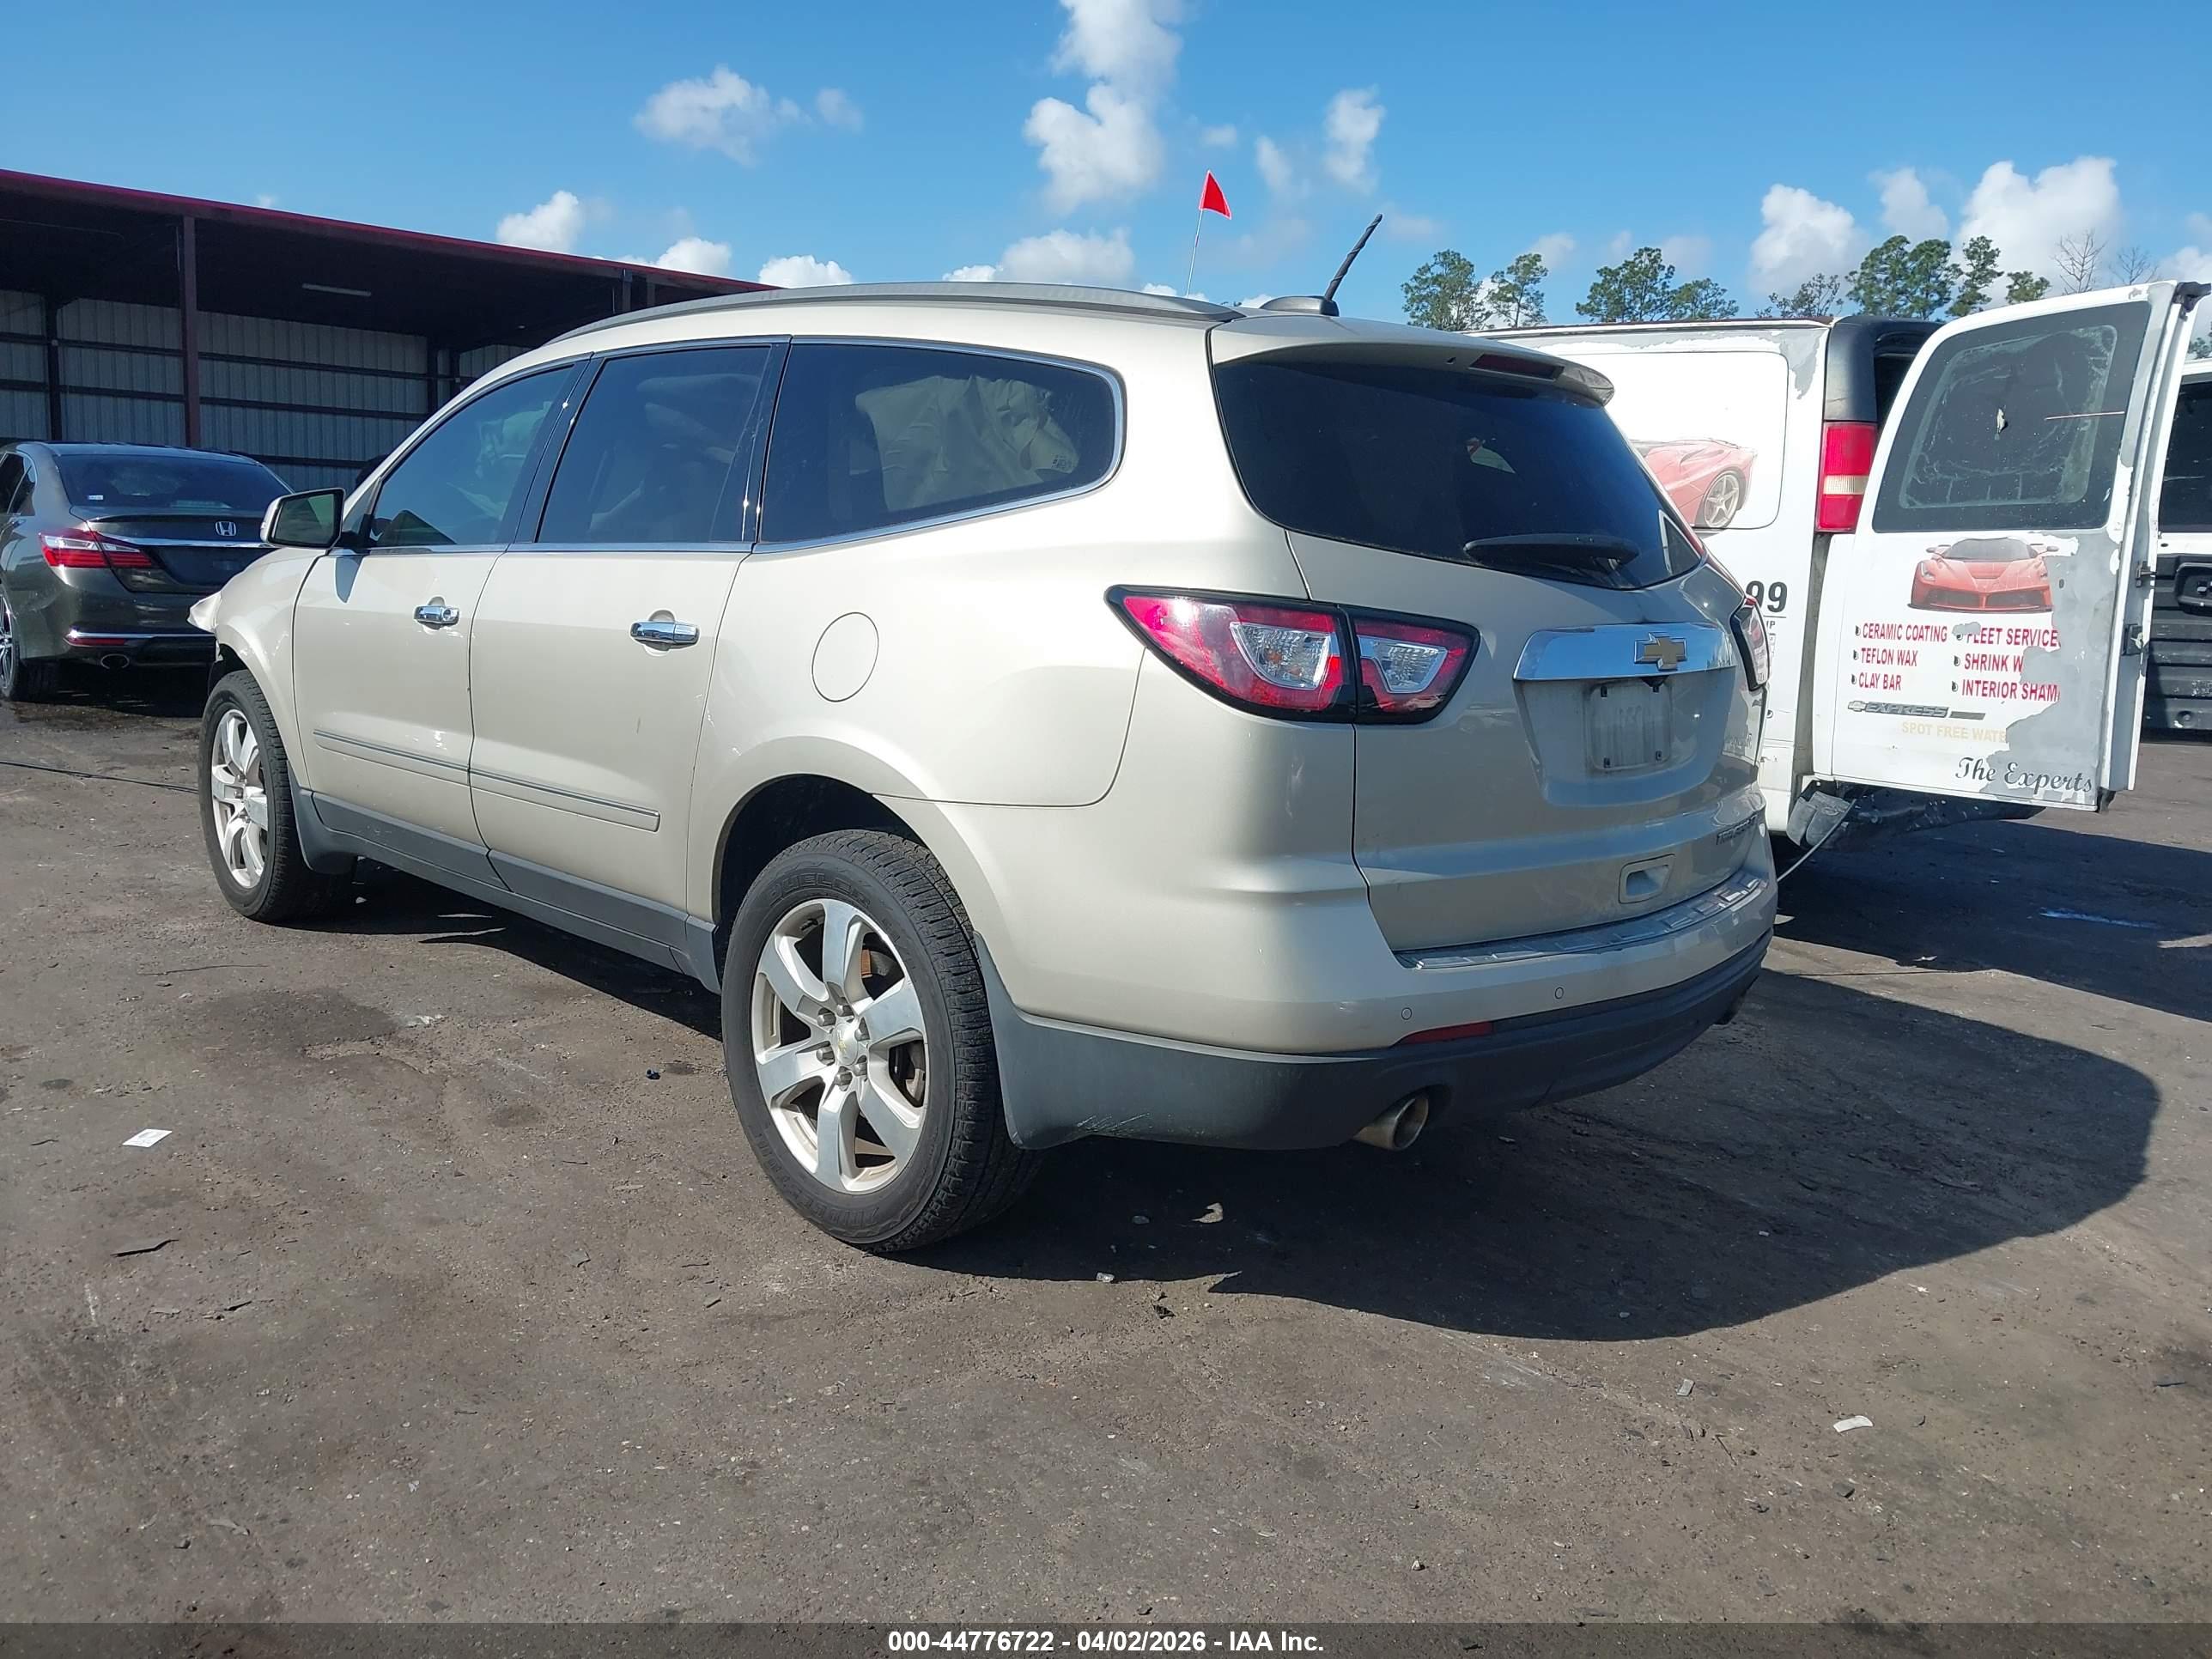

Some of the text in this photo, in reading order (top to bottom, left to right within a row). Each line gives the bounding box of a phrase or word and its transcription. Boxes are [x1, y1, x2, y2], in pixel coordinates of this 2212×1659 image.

[1863, 623, 1948, 643] CERAMIC COATING
[2005, 628, 2062, 648] SERVICE
[1861, 647, 1918, 667] TEFLON WAX
[1964, 653, 2009, 672] SHRINK
[1858, 672, 1902, 691] CLAY BAR
[1961, 678, 2018, 700] INTERIOR
[1865, 701, 1949, 719] EXPRESS
[1902, 720, 1933, 736] SPOT
[1936, 725, 1969, 740] FREE
[1955, 757, 2093, 795] The Experts
